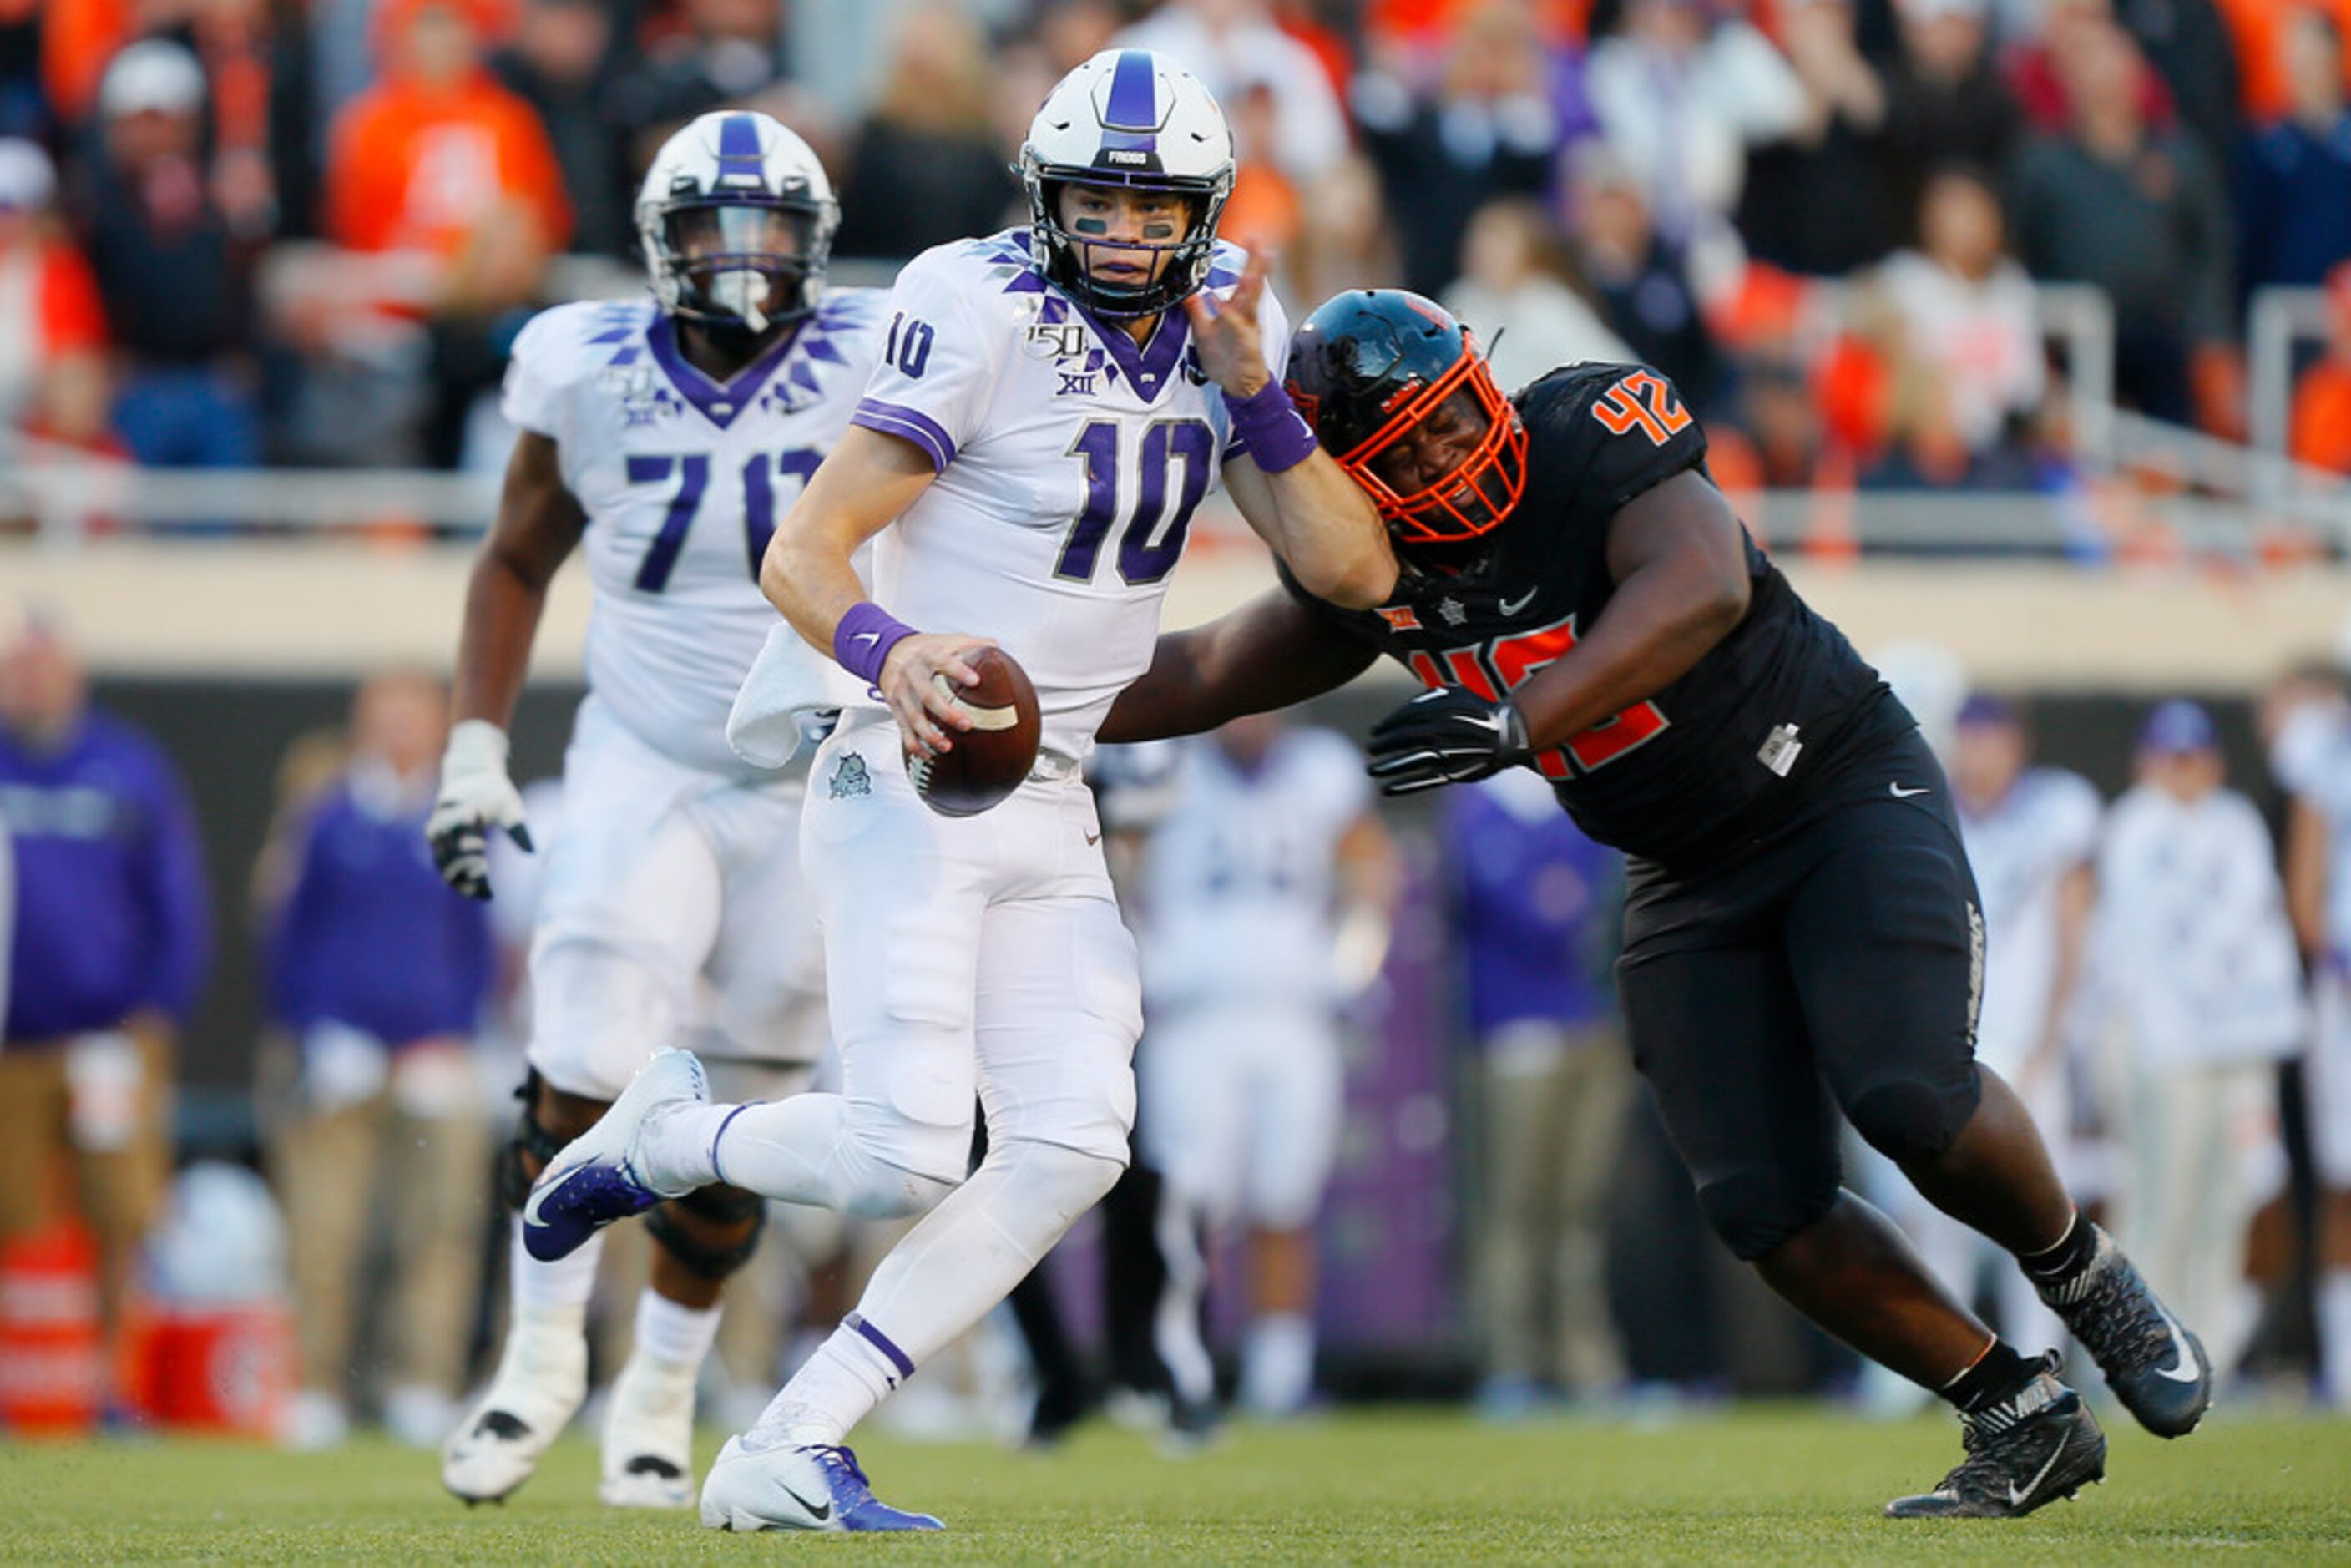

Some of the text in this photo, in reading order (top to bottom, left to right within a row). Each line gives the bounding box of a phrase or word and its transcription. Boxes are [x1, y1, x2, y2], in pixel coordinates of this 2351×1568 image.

[1108, 150, 1147, 164] FROGS
[884, 311, 936, 380] 10
[1055, 372, 1098, 396] XII
[1590, 369, 1694, 447] 42
[1051, 417, 1216, 586] 10
